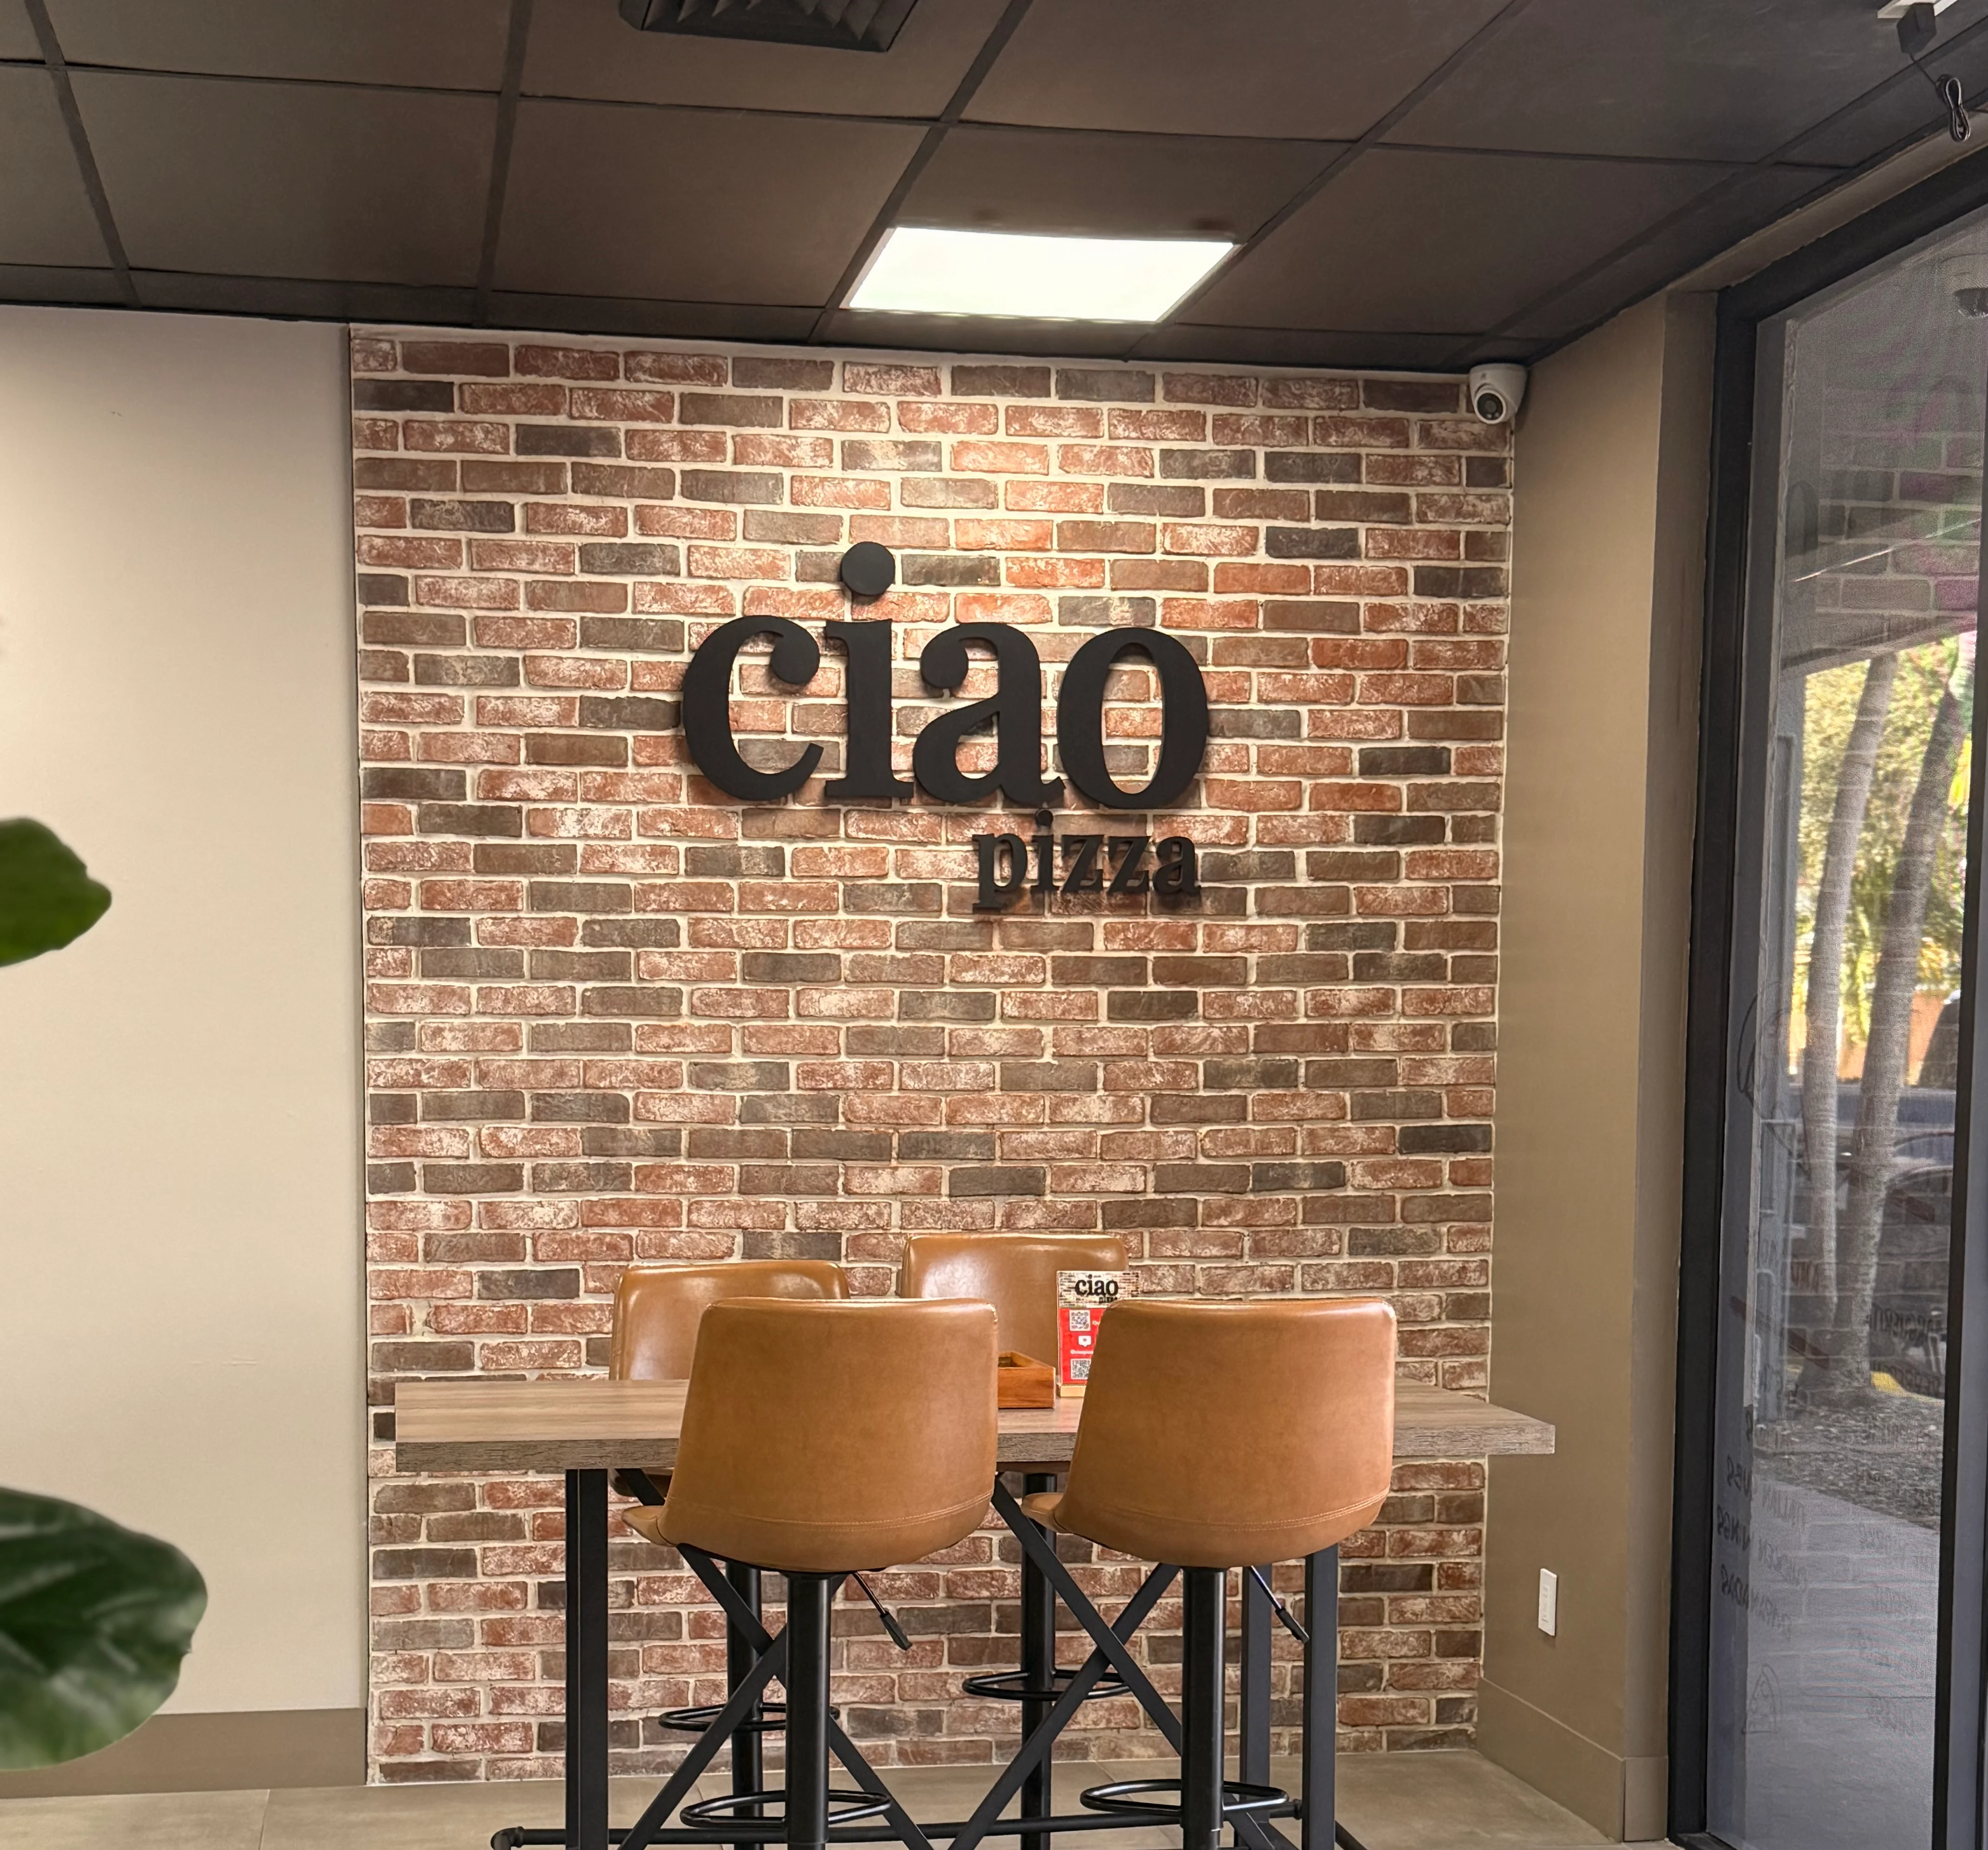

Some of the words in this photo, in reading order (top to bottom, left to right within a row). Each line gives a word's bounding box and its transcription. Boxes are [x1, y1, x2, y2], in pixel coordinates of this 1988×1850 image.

[683, 541, 1207, 810] ciao
[973, 809, 1201, 911] pizza
[1075, 1274, 1119, 1296] ciao
